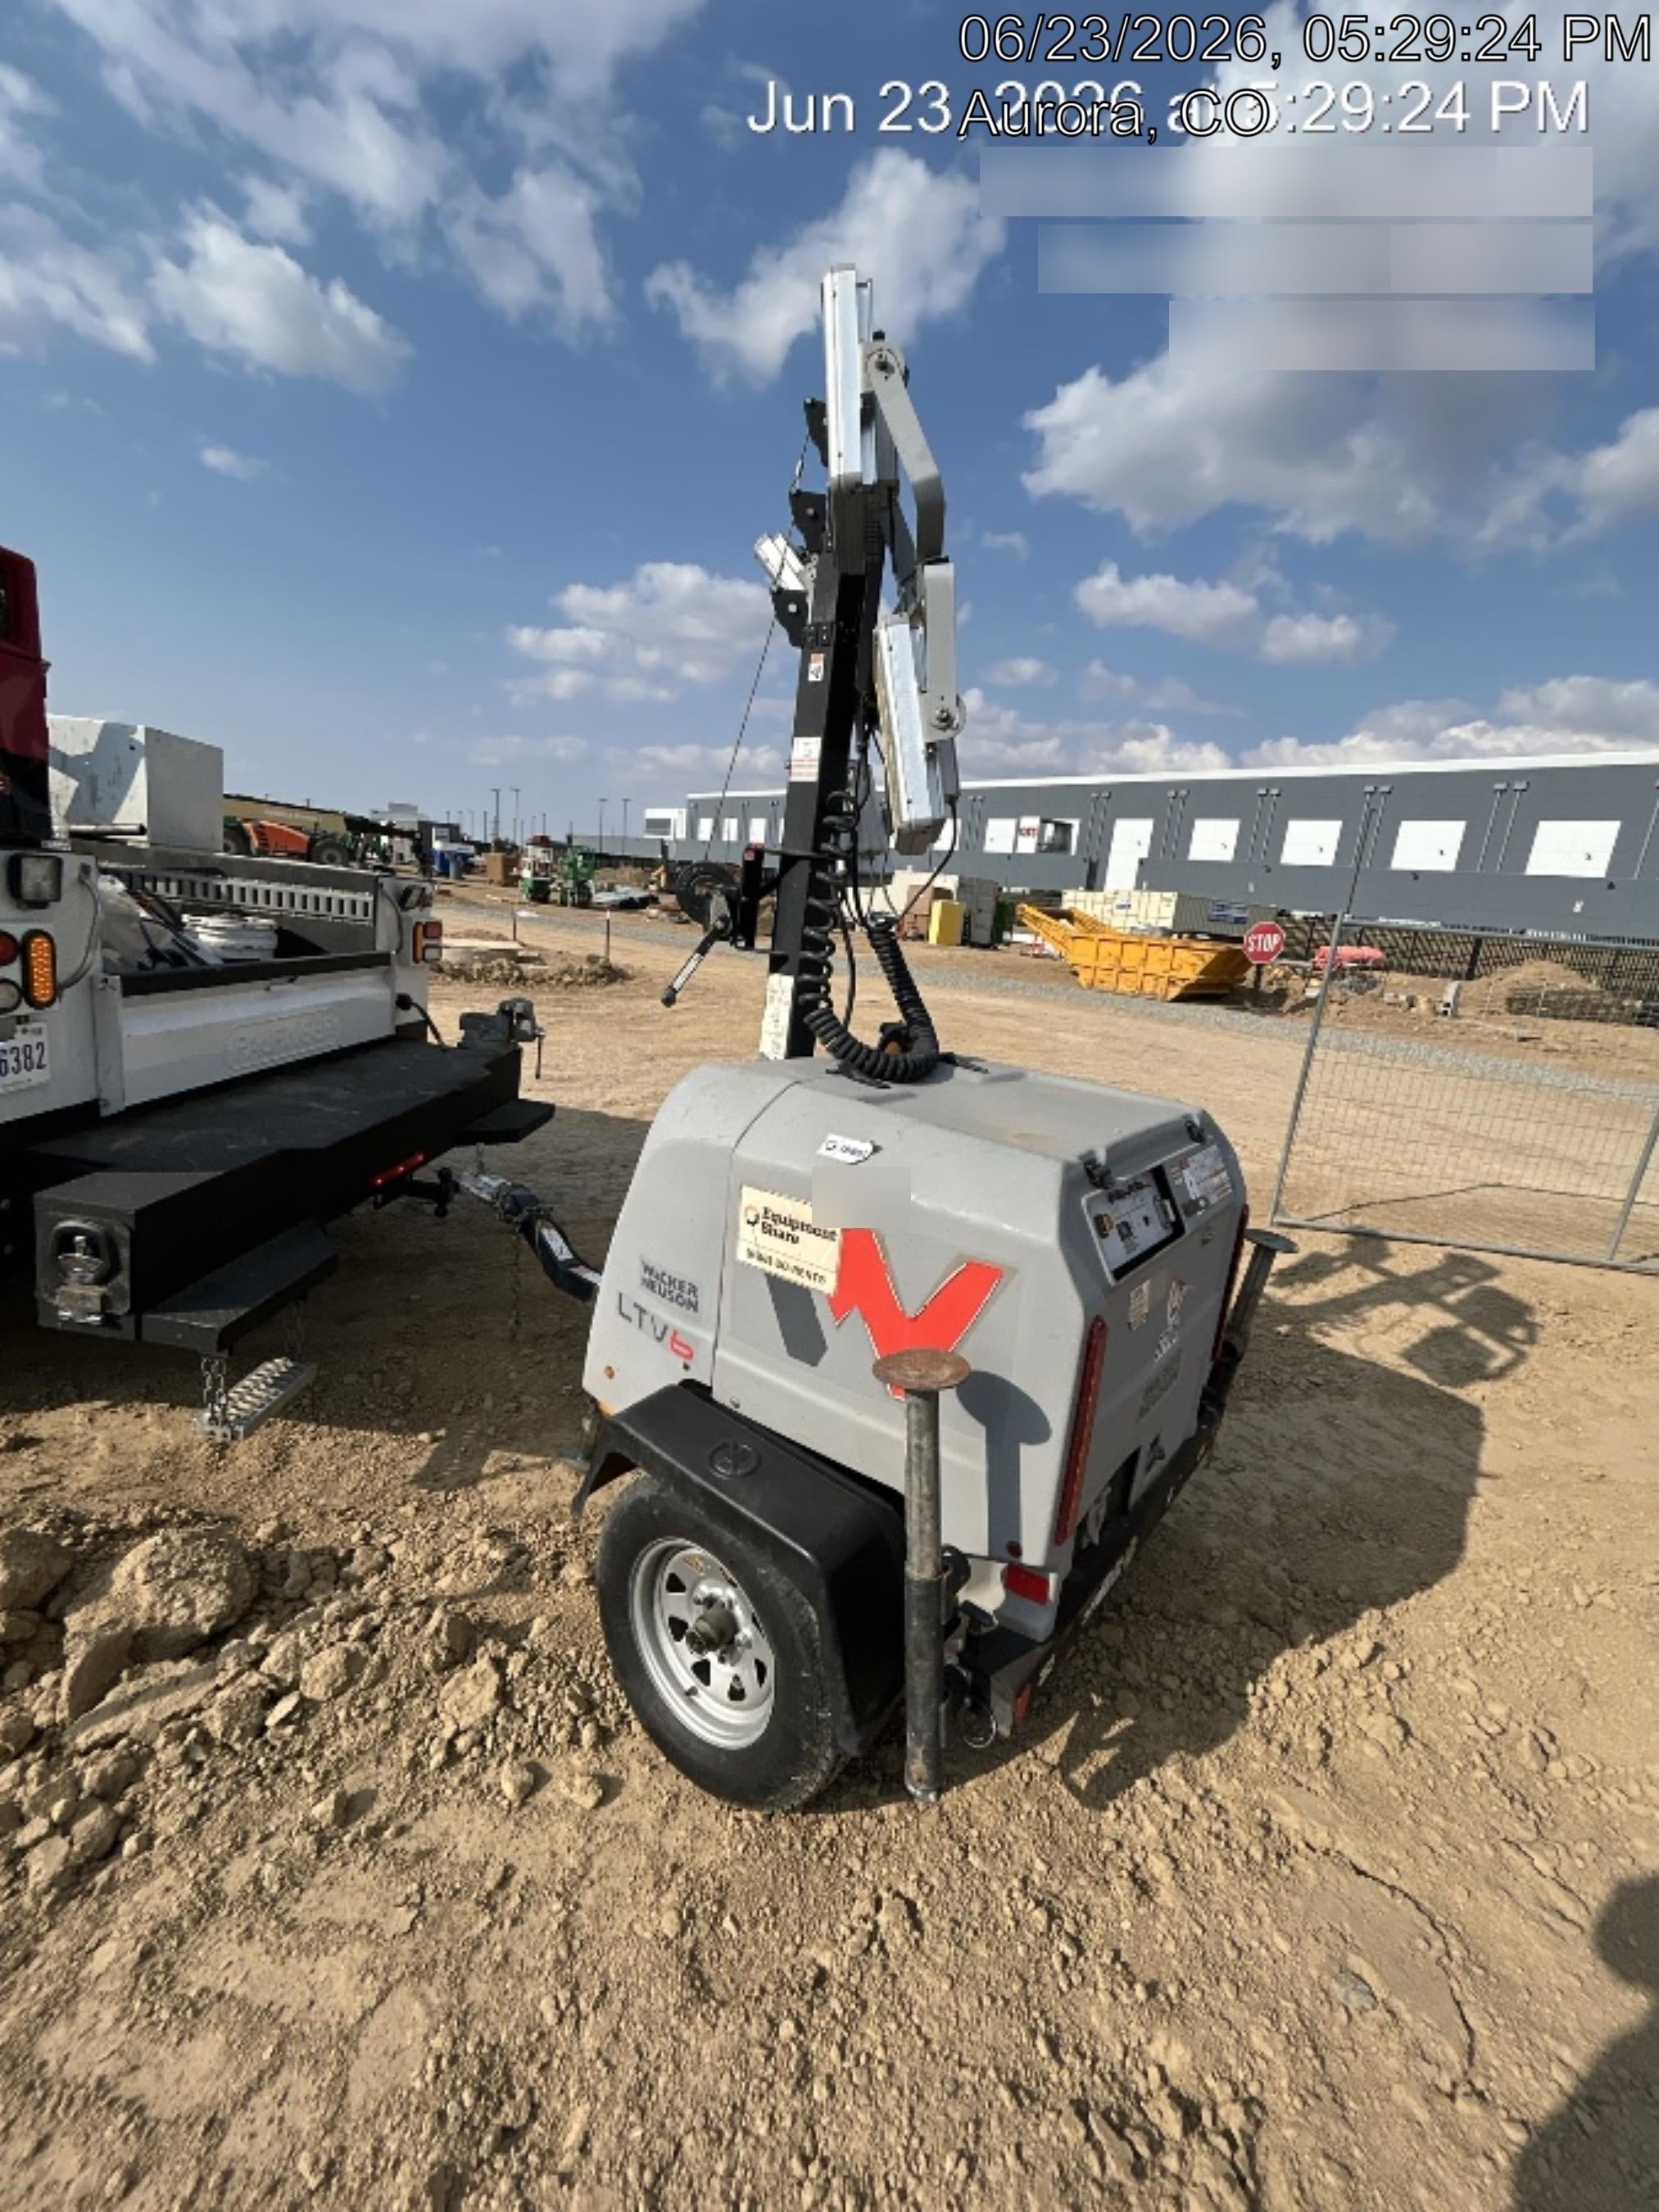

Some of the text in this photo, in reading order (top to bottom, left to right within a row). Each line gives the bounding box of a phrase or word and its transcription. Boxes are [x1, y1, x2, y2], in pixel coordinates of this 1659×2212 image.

[1248, 933, 1281, 953] STOP
[640, 1260, 698, 1296] WACKER
[641, 1276, 699, 1312] NEUSON
